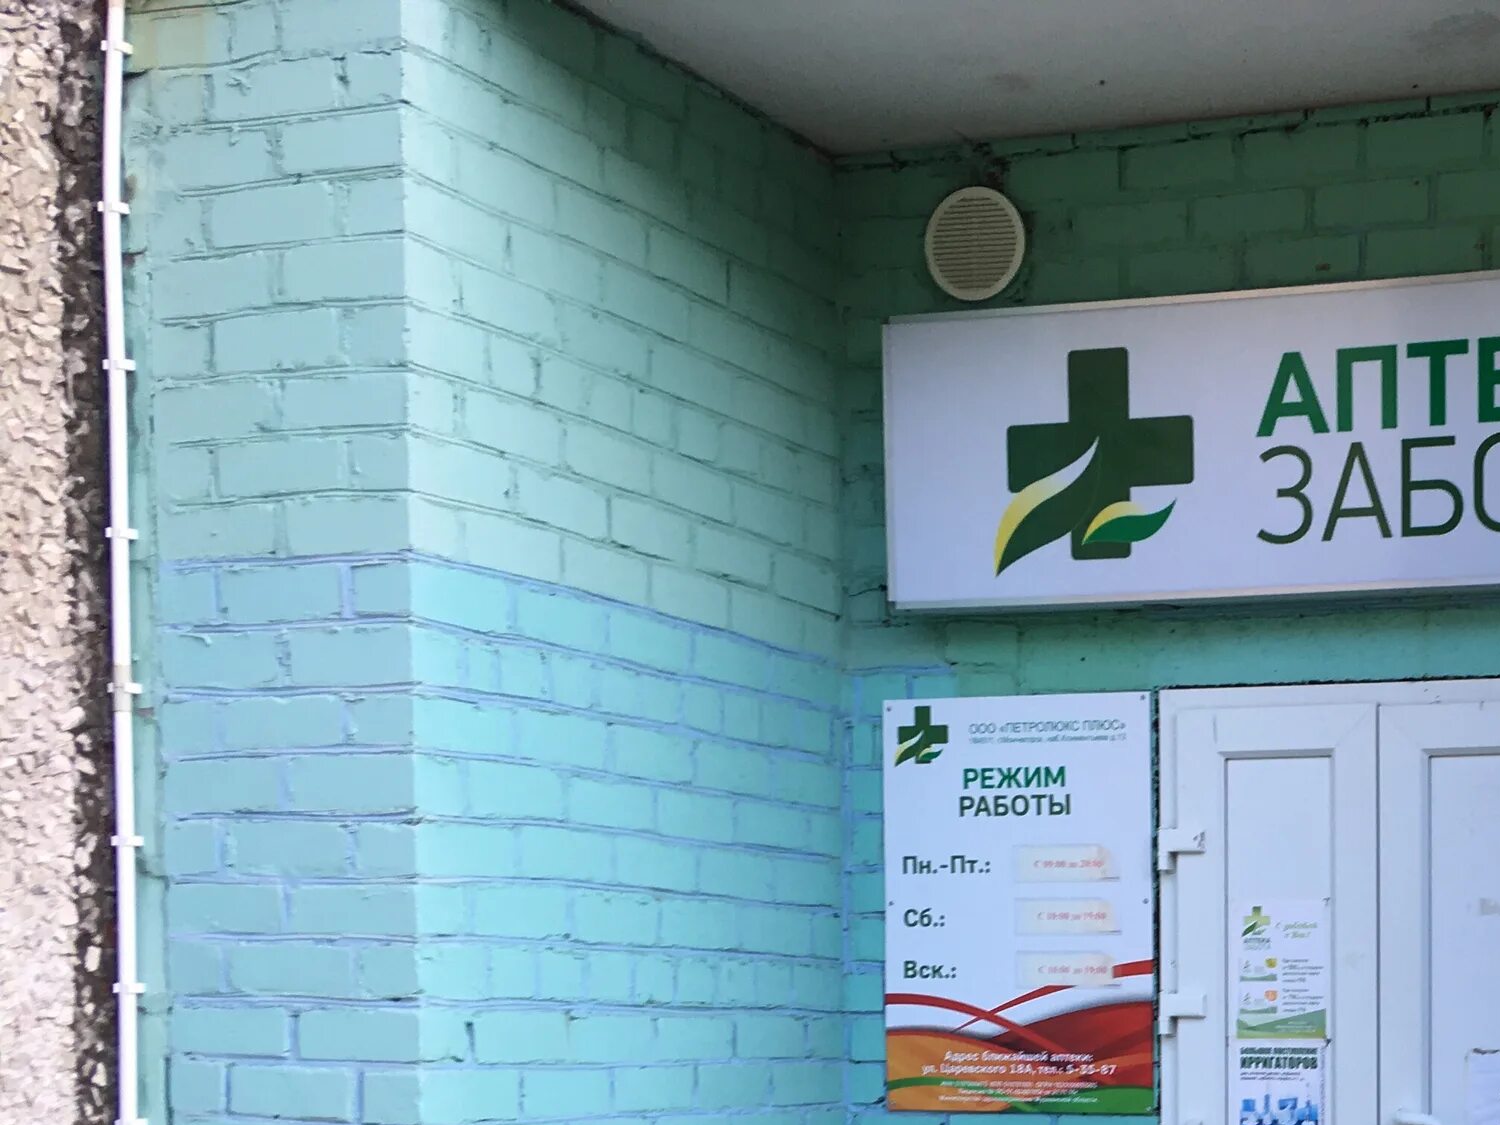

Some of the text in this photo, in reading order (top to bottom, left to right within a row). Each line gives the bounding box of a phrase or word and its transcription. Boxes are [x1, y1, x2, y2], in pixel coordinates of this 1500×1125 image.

[968, 722, 996, 734] ООО
[963, 766, 1066, 789] РЕЖИМ
[959, 793, 1071, 817] РАБОТЫ
[902, 855, 991, 875] Пн.-Пт.:
[903, 907, 946, 928] Сб.:
[903, 960, 957, 979] Вск.:
[1240, 1056, 1318, 1069] ИРРИГАТОРОВ
